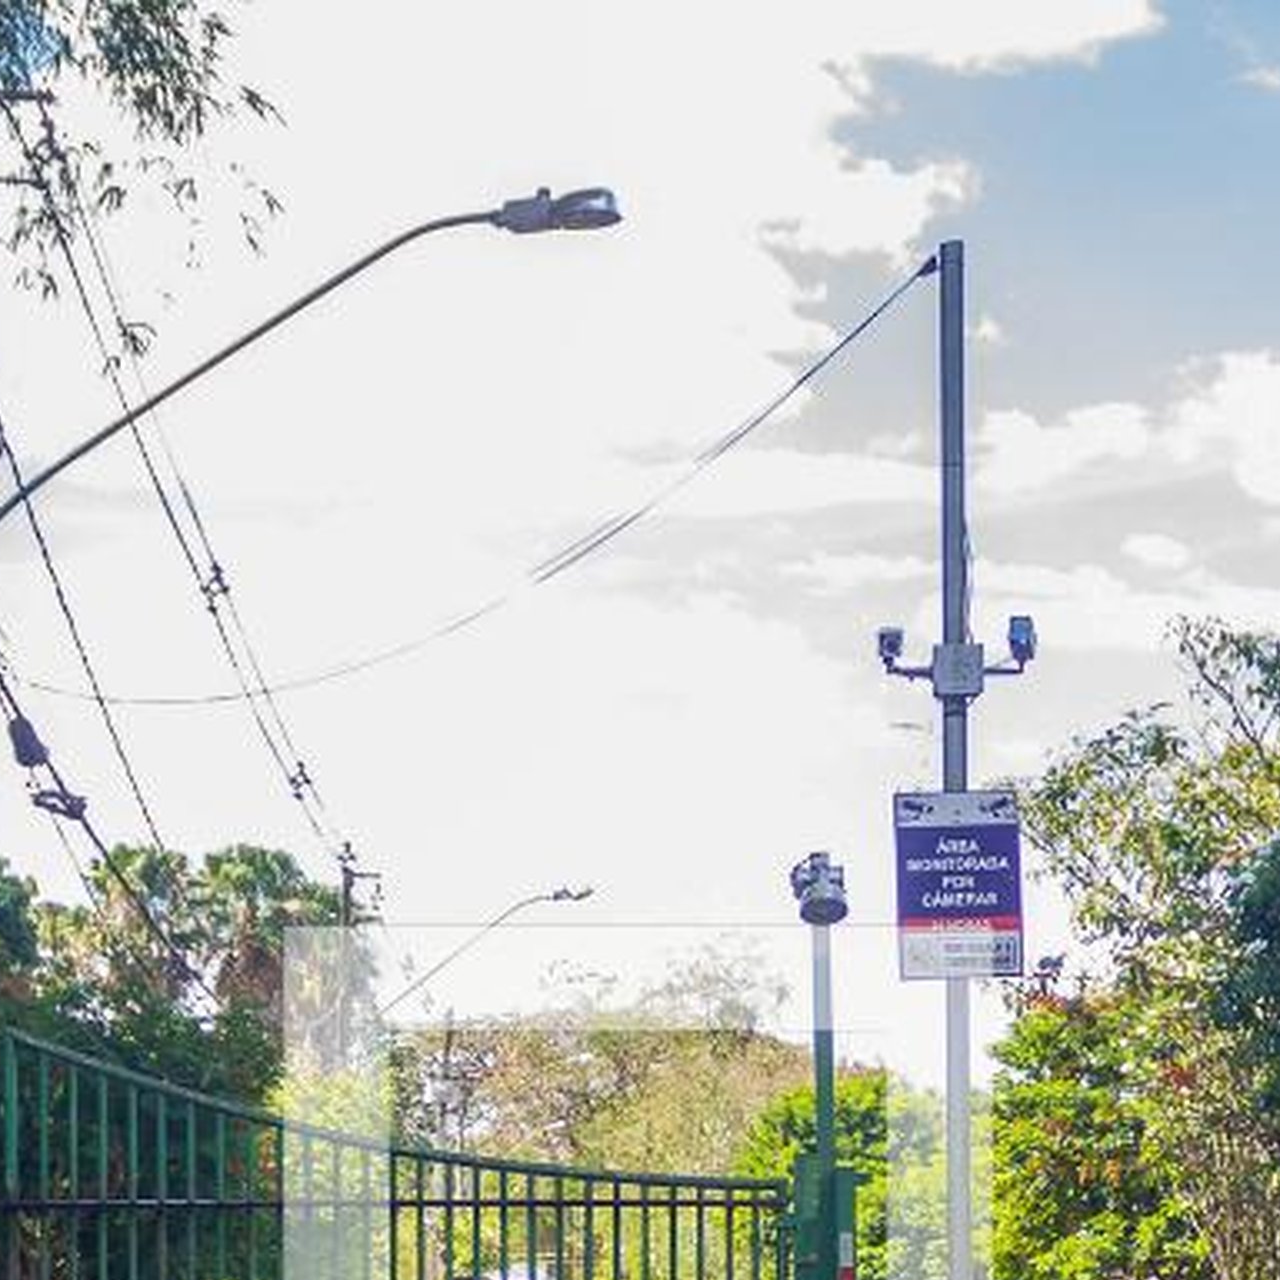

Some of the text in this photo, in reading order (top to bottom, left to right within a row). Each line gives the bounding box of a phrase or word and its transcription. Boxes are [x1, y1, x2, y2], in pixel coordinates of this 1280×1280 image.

[935, 836, 980, 854] ÁREA
[906, 857, 1010, 872] MONITORADA
[942, 875, 975, 888] POR
